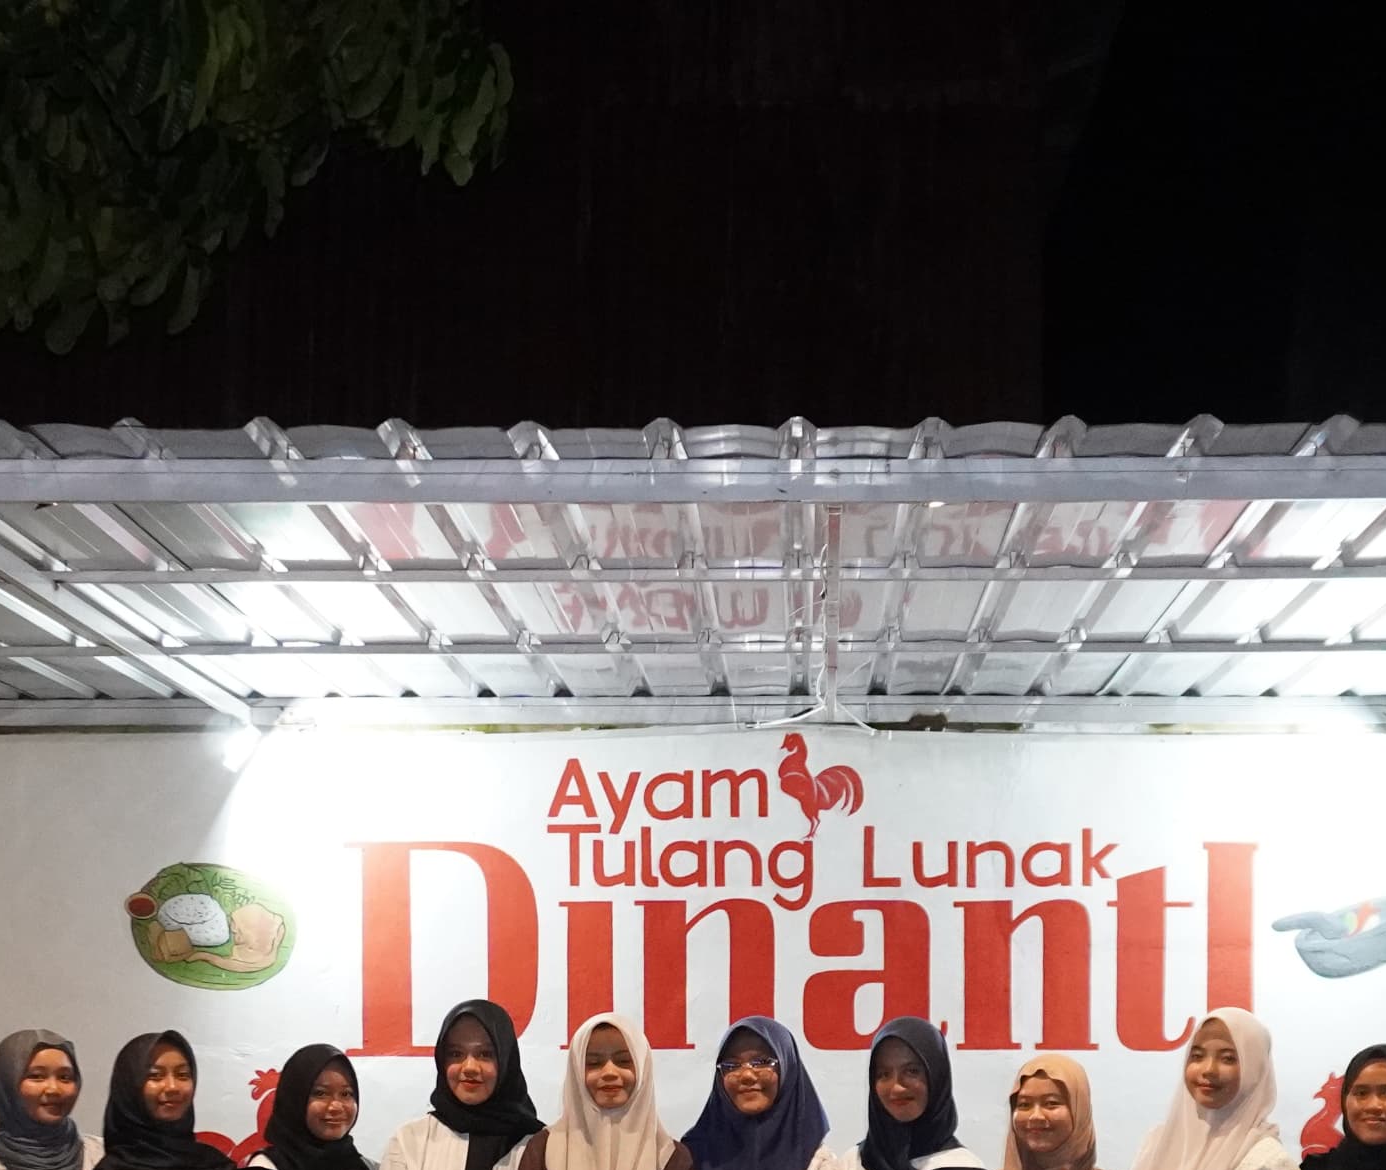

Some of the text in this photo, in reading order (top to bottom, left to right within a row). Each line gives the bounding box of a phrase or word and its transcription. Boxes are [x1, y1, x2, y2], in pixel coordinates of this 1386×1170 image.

[547, 758, 769, 834] Ayam
[547, 824, 1119, 911] Tulang Lunak
